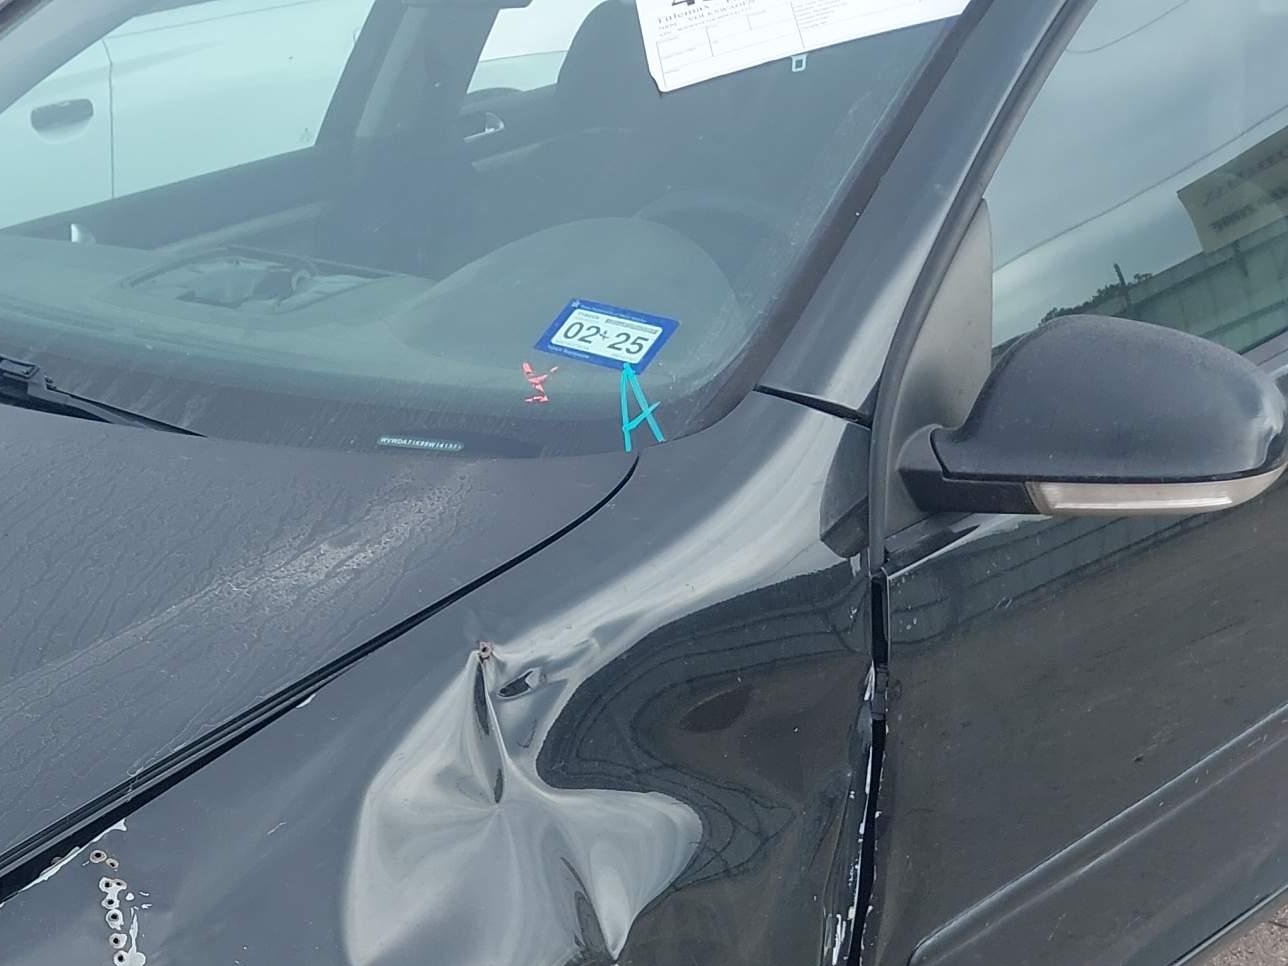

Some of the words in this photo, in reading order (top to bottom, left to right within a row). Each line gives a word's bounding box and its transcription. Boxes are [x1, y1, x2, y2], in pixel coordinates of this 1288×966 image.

[563, 321, 601, 345] 02
[608, 332, 650, 355] 25
[621, 362, 665, 452] A
